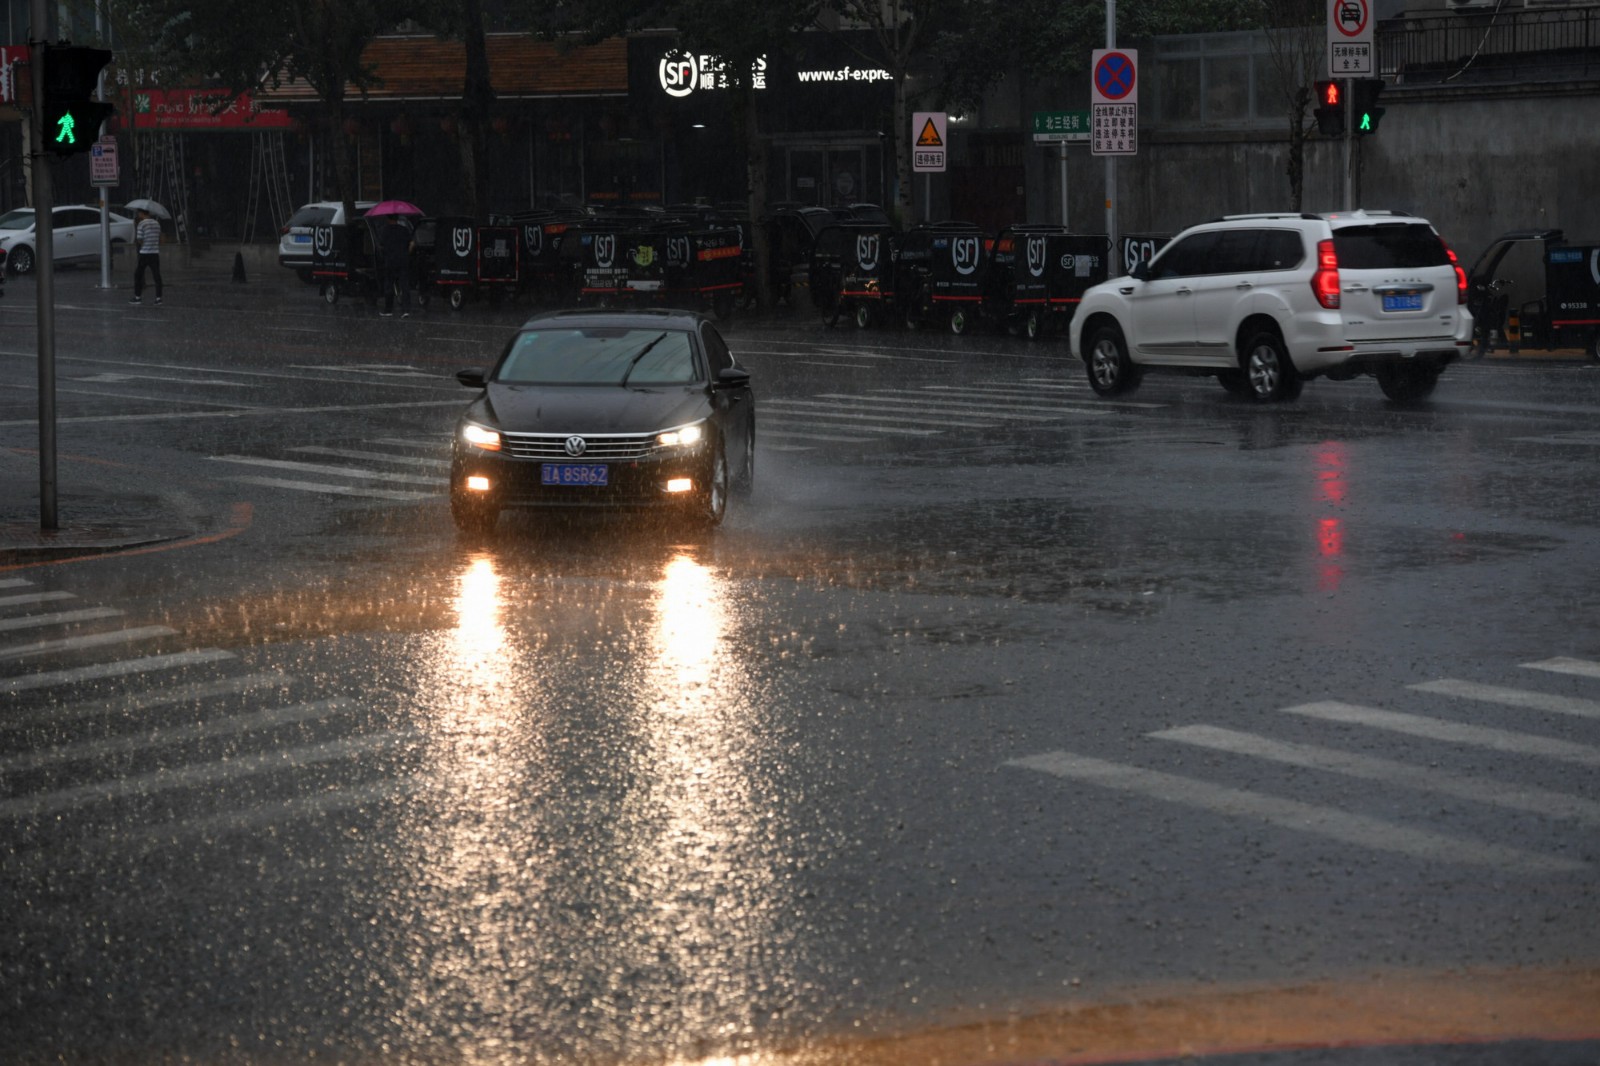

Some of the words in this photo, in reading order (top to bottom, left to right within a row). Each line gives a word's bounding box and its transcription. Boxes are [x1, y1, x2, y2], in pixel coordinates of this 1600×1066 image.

[1343, 59, 1360, 69] 全天
[798, 66, 893, 83] www.sf-expre
[700, 72, 766, 89] 顺运
[1096, 107, 1134, 116] 全线禁止停车
[1046, 116, 1080, 130] 北三经街
[1096, 129, 1134, 138] 违法停车将
[1096, 140, 1134, 150] 依法处罚
